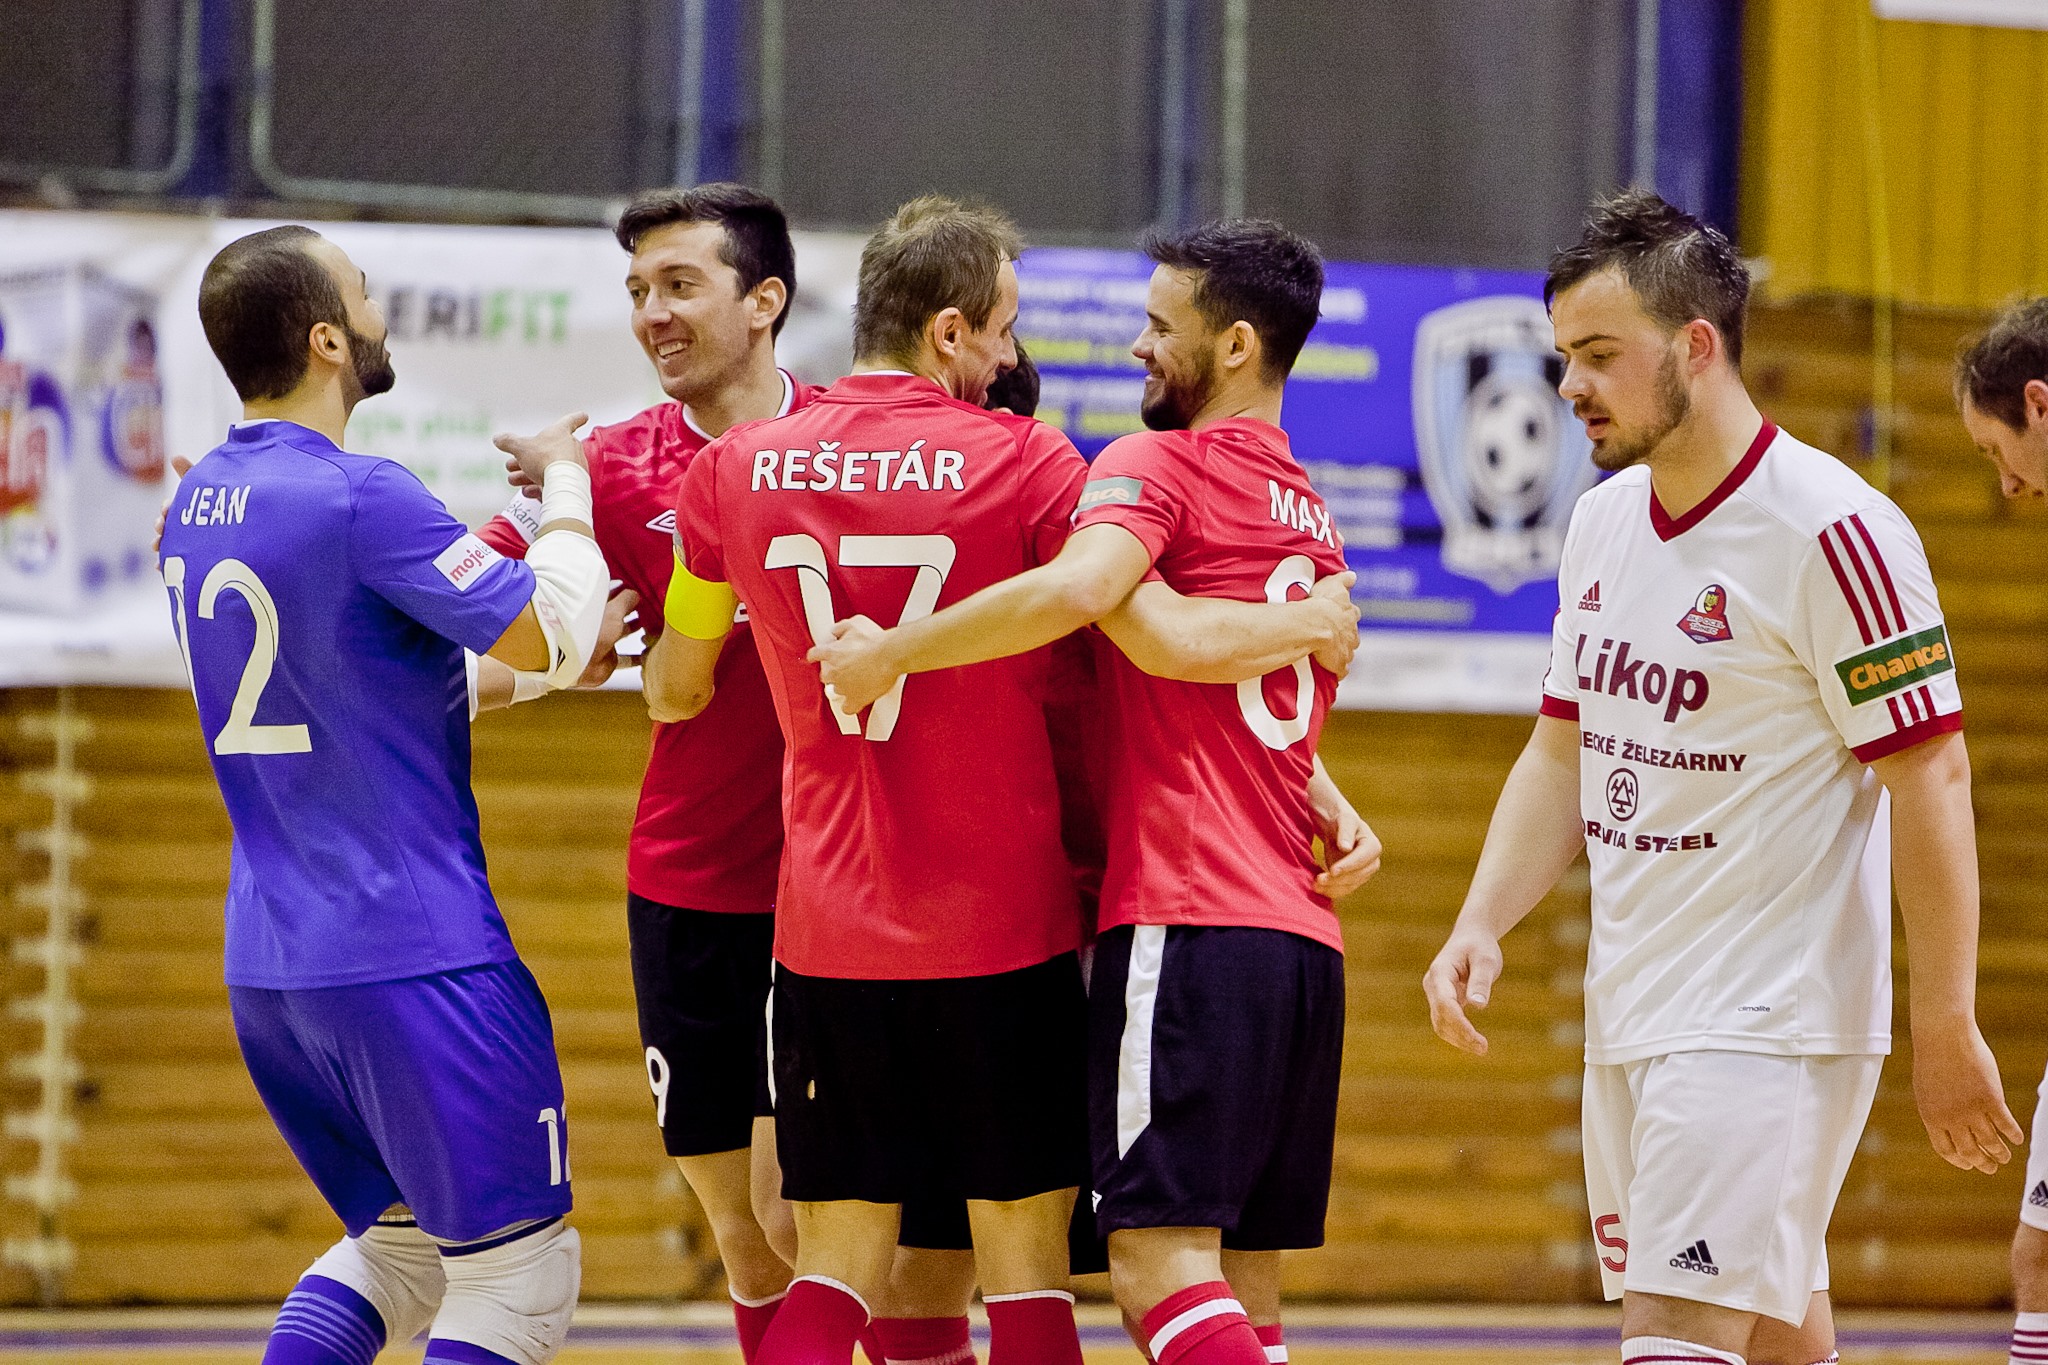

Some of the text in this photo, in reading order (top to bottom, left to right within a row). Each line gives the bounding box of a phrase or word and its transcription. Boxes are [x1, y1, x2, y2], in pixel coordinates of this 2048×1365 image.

[384, 284, 574, 343] ERIFIT
[750, 439, 966, 492] REŠETÁR
[180, 484, 251, 526] JEAN
[1267, 478, 1336, 550] MAX
[1578, 600, 1601, 612] adidas
[764, 533, 957, 742] 17
[1575, 633, 1710, 723] Likop
[1849, 641, 1946, 690] Chance
[1621, 738, 1747, 772] ŽELEZÁRNY
[1584, 820, 1718, 853] RVIA STEEL
[645, 1046, 670, 1128] 9
[537, 1107, 572, 1186] 1
[1669, 1257, 1719, 1277] adidas
